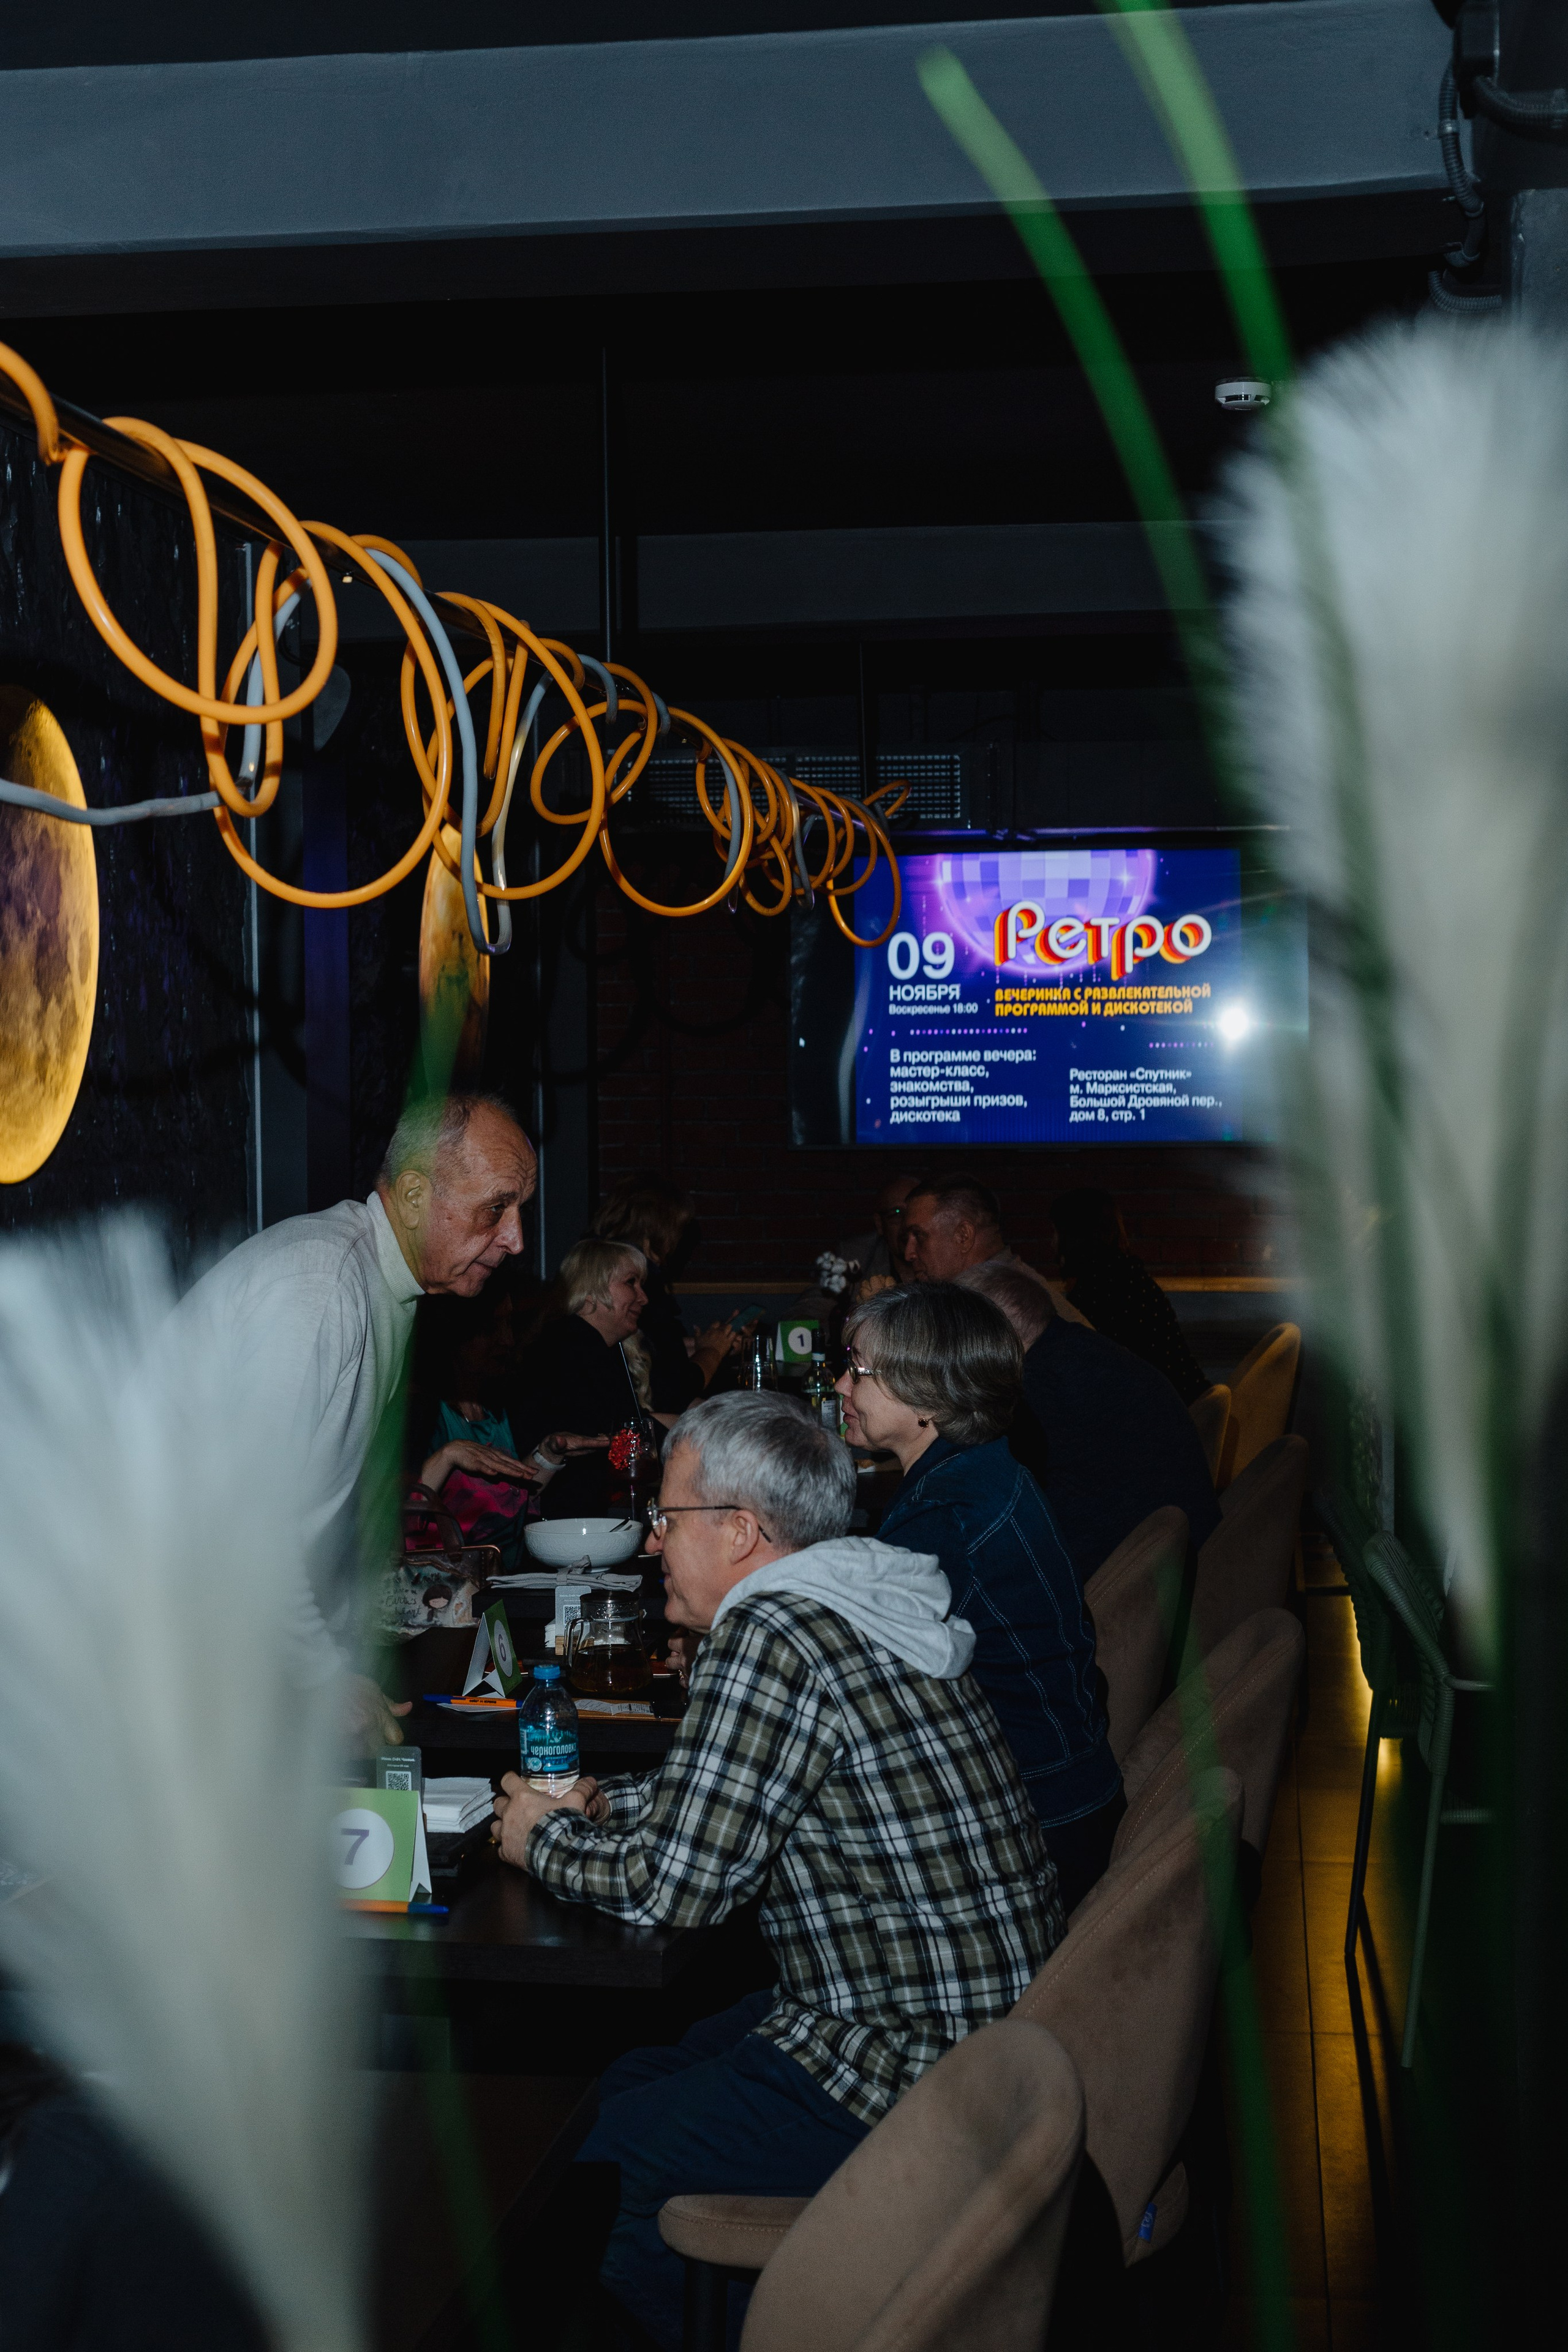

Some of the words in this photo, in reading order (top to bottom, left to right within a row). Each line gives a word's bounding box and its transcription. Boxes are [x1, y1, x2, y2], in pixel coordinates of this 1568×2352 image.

[995, 901, 1212, 981] Ретро
[888, 932, 955, 980] 09
[889, 984, 960, 1001] НОЯБРЯ
[995, 987, 1071, 1001] ВЕЧЕРИНКА
[1074, 987, 1082, 1000] С
[1084, 983, 1211, 1000] РАЗВЛЕКАТЕЛЬНОЙ
[889, 1004, 951, 1016] Воскресенье
[953, 1003, 978, 1014] 18:00
[995, 1000, 1088, 1017] ПРОГРАММОЙ
[1091, 1003, 1101, 1015] И
[1104, 998, 1193, 1017] ДИСКОТЕКОЙ
[890, 1049, 900, 1063] В
[903, 1050, 981, 1065] программе
[983, 1049, 1036, 1064] вечера:
[890, 1065, 989, 1080] мастер-класс,
[1069, 1068, 1127, 1082] Ресторан
[1129, 1067, 1192, 1082] «Спутник»
[890, 1080, 974, 1093] знакомства,
[1069, 1084, 1084, 1095] м.
[1085, 1082, 1177, 1096] Марксистская,
[890, 1095, 971, 1110] розыгрыши
[973, 1095, 1028, 1108] призов,
[1069, 1095, 1126, 1108] Большой
[1127, 1094, 1189, 1109] Дровяной
[1191, 1095, 1223, 1108] пер.,
[889, 1110, 960, 1125] дискотека
[1069, 1110, 1095, 1123] дом
[1097, 1109, 1109, 1122] 8,
[1111, 1110, 1136, 1123] стр.
[1139, 1108, 1145, 1121] 1
[797, 1334, 804, 1347] 1
[498, 1634, 507, 1662] 6
[341, 1828, 369, 1865] 7
